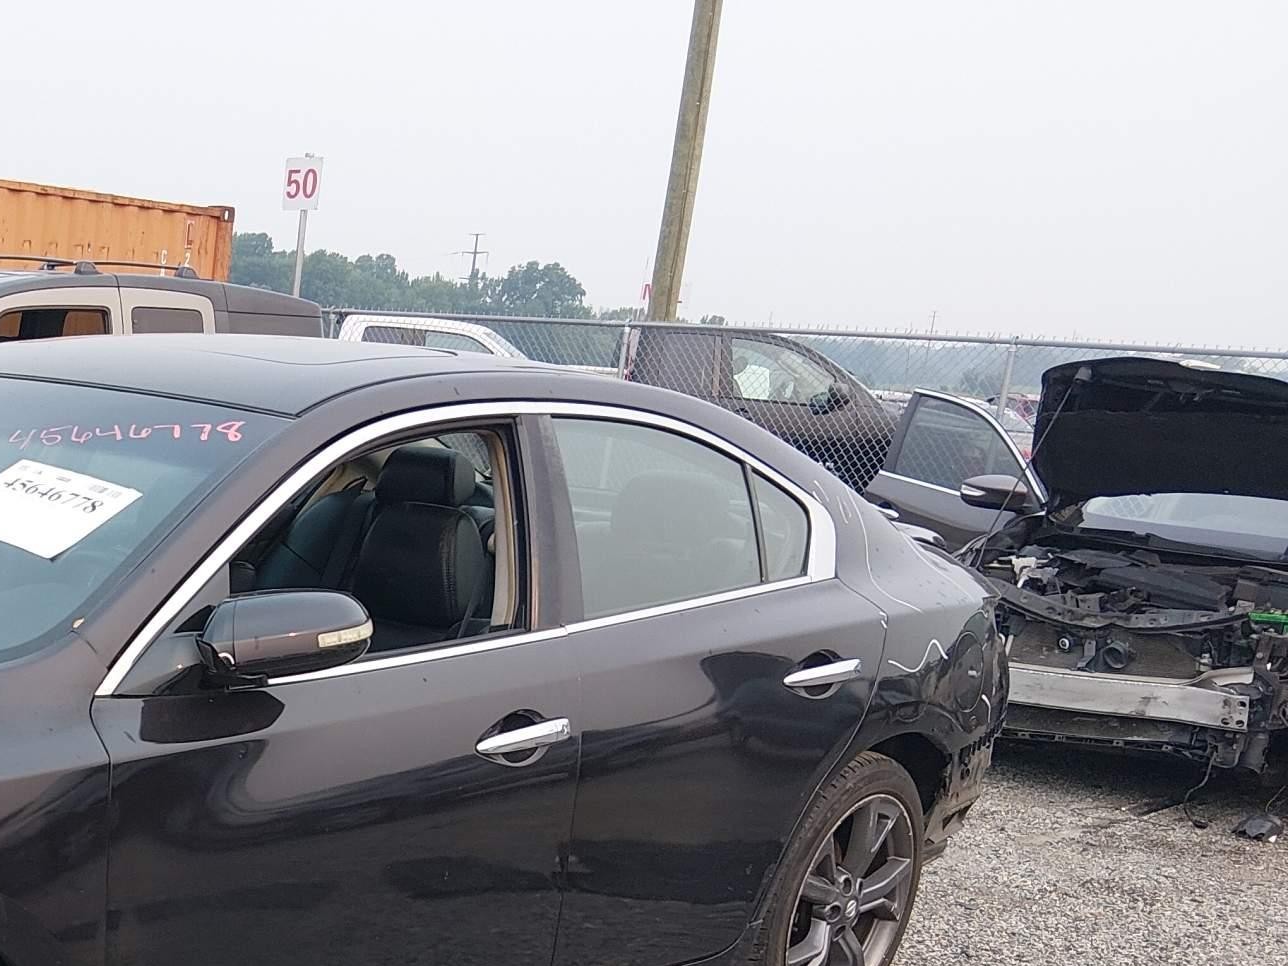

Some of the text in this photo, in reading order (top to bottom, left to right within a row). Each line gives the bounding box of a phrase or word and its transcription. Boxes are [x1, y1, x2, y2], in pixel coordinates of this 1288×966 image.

[286, 168, 318, 199] 50
[9, 421, 247, 449] 45646778
[3, 477, 105, 513] 45646778
